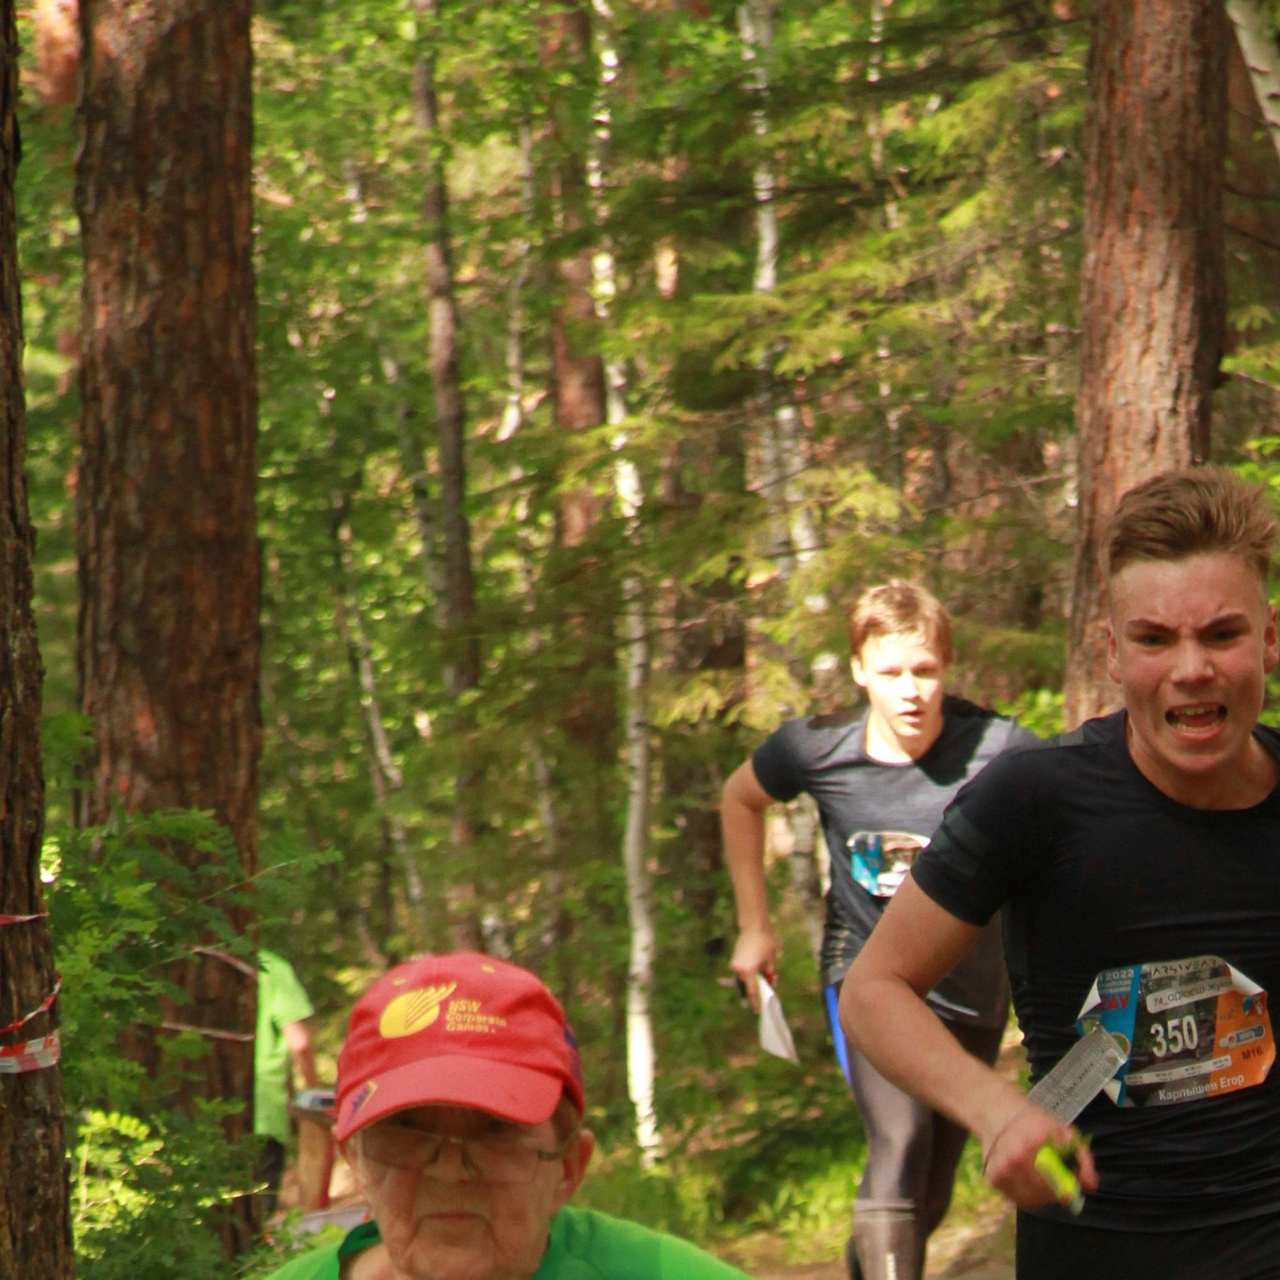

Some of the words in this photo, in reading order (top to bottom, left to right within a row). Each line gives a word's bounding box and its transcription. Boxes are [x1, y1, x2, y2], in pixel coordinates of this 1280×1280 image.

[449, 999, 482, 1013] NSW
[446, 1012, 507, 1027] Corporate
[1150, 1014, 1199, 1058] 350
[1219, 1074, 1245, 1089] Егор
